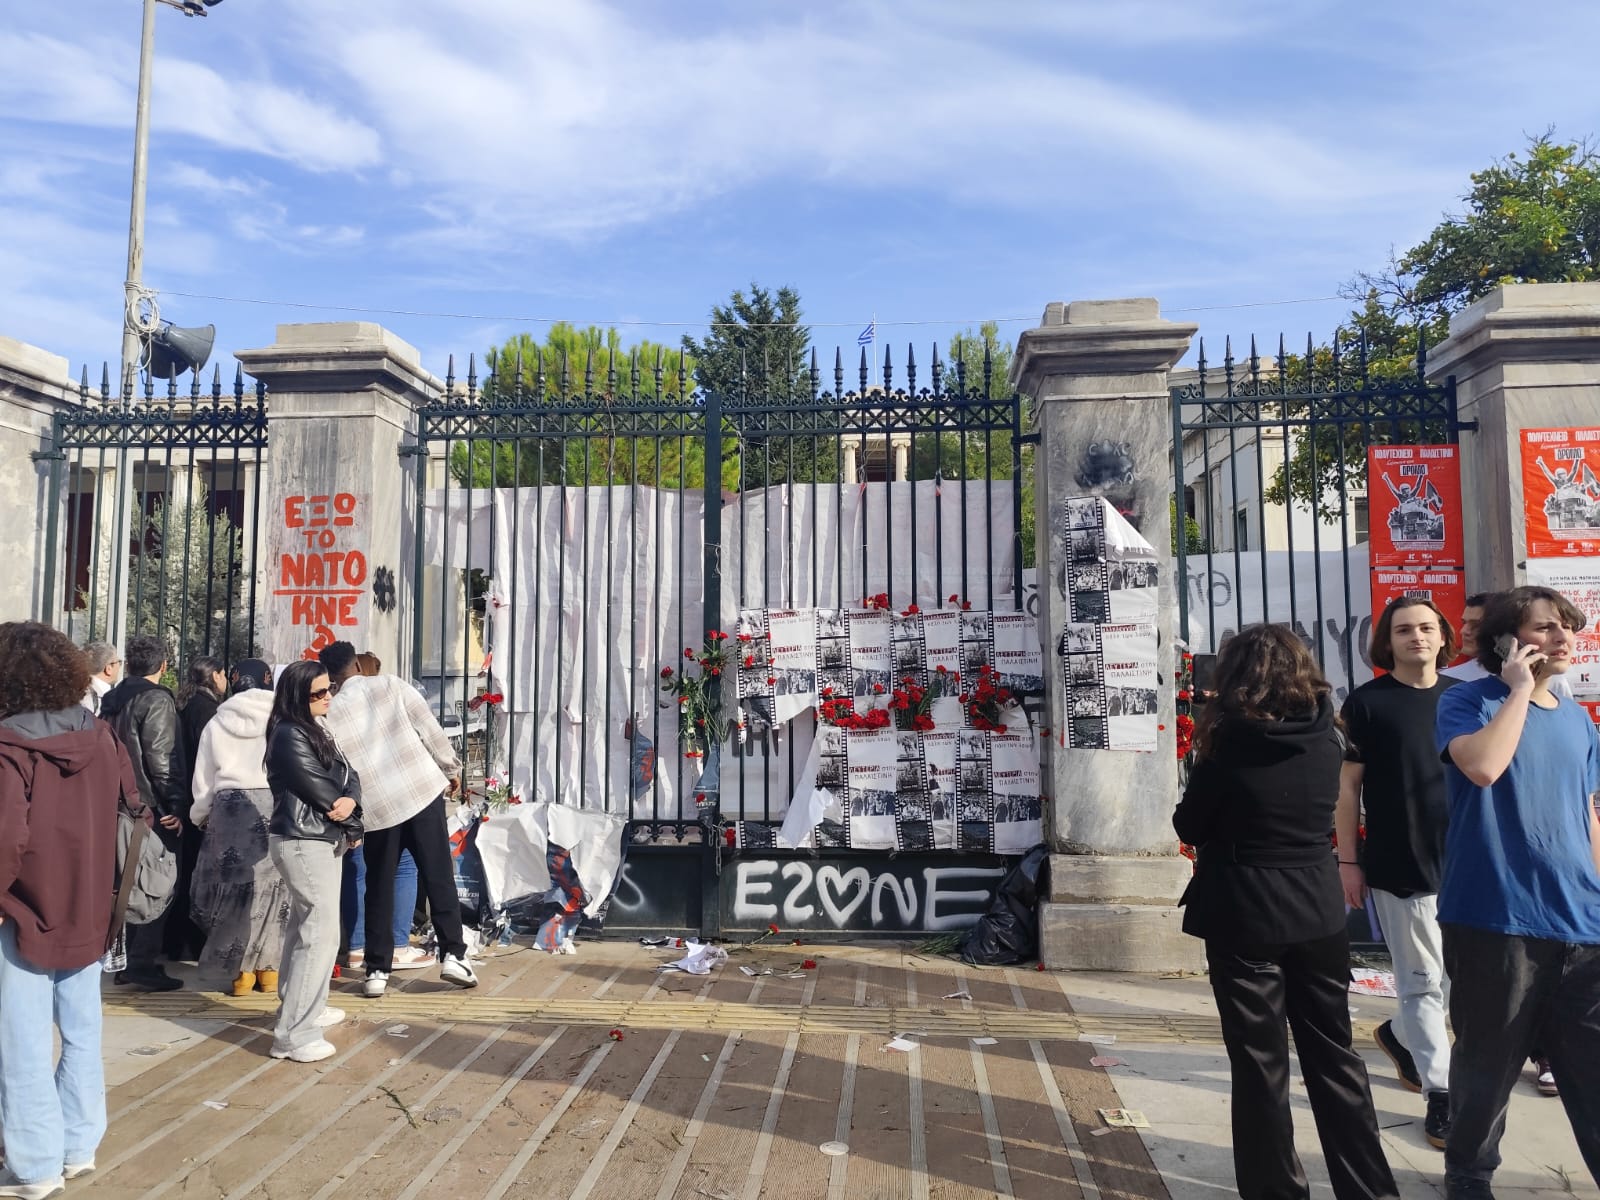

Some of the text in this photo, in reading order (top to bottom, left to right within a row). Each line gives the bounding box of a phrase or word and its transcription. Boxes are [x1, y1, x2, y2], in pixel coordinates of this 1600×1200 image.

[302, 529, 336, 549] ΤΟ
[280, 550, 368, 587] ΝΑΤΟ
[291, 595, 359, 626] ΚΝΕ
